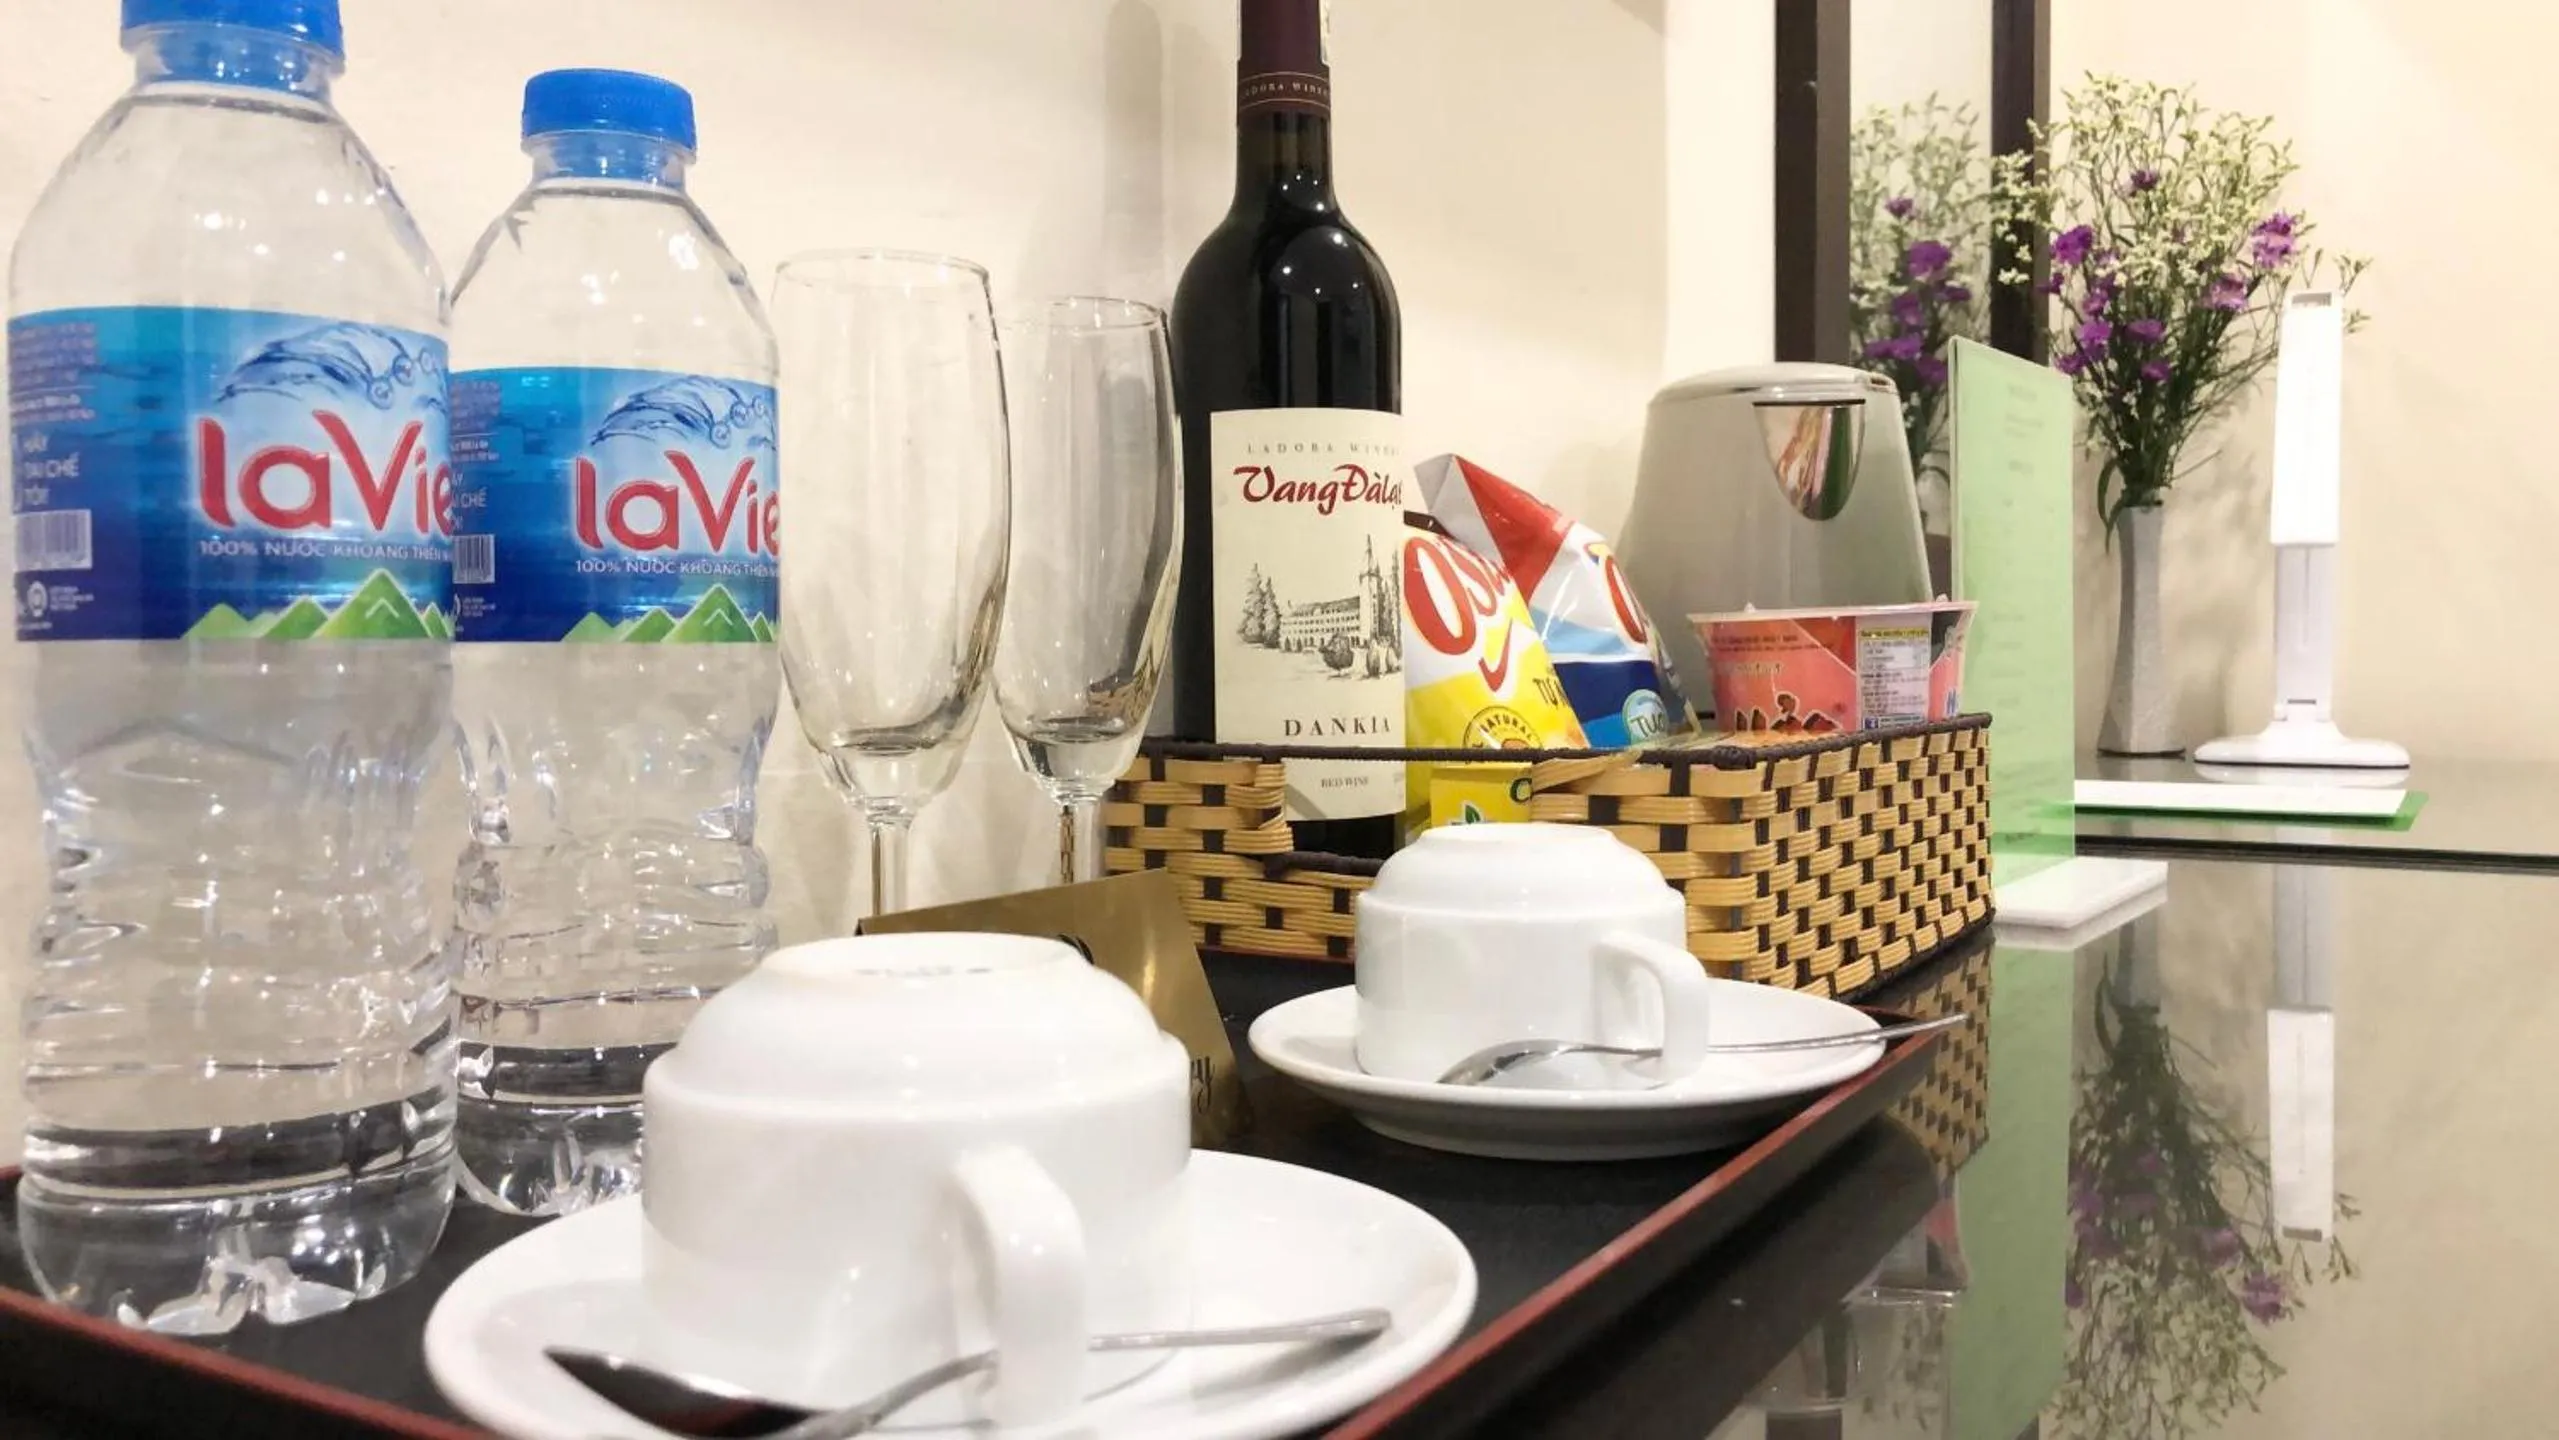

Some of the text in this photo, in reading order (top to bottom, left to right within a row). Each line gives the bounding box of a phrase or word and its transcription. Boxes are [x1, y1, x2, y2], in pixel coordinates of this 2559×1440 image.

[195, 408, 453, 537] laVie
[574, 448, 780, 557] laVie
[200, 540, 258, 556] 100%
[576, 559, 620, 573] 100%
[1284, 715, 1391, 736] DANKIA
